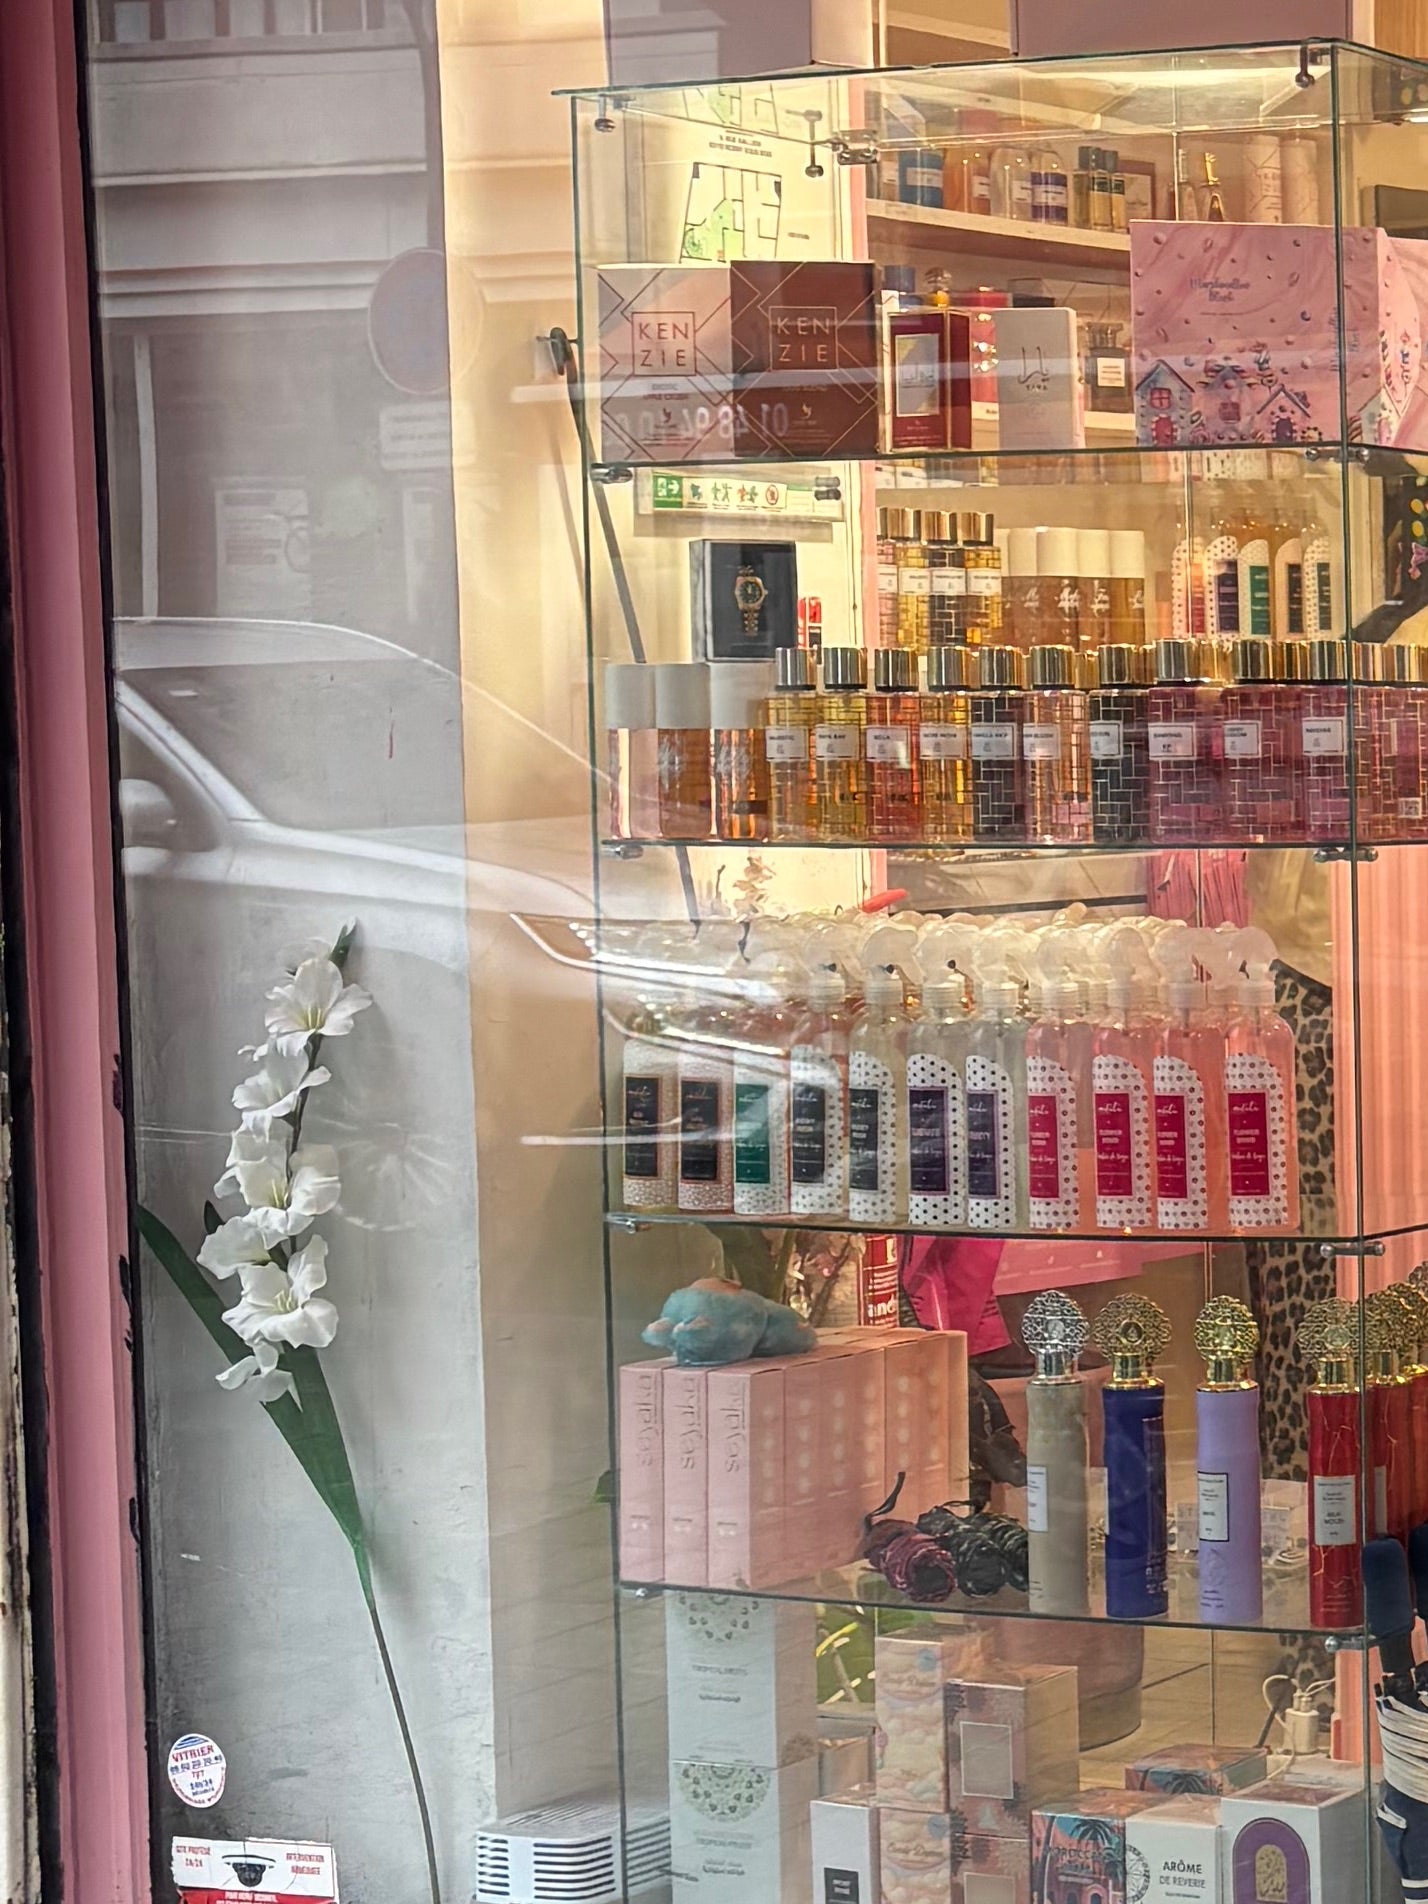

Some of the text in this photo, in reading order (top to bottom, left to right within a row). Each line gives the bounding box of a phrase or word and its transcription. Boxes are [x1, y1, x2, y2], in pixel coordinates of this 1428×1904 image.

[638, 321, 689, 341] KEN
[777, 316, 831, 336] KEN
[639, 348, 687, 368] ZIE
[778, 343, 828, 363] ZIE
[171, 1744, 215, 1763] VITRIER
[1162, 1857, 1204, 1876] ARÔME
